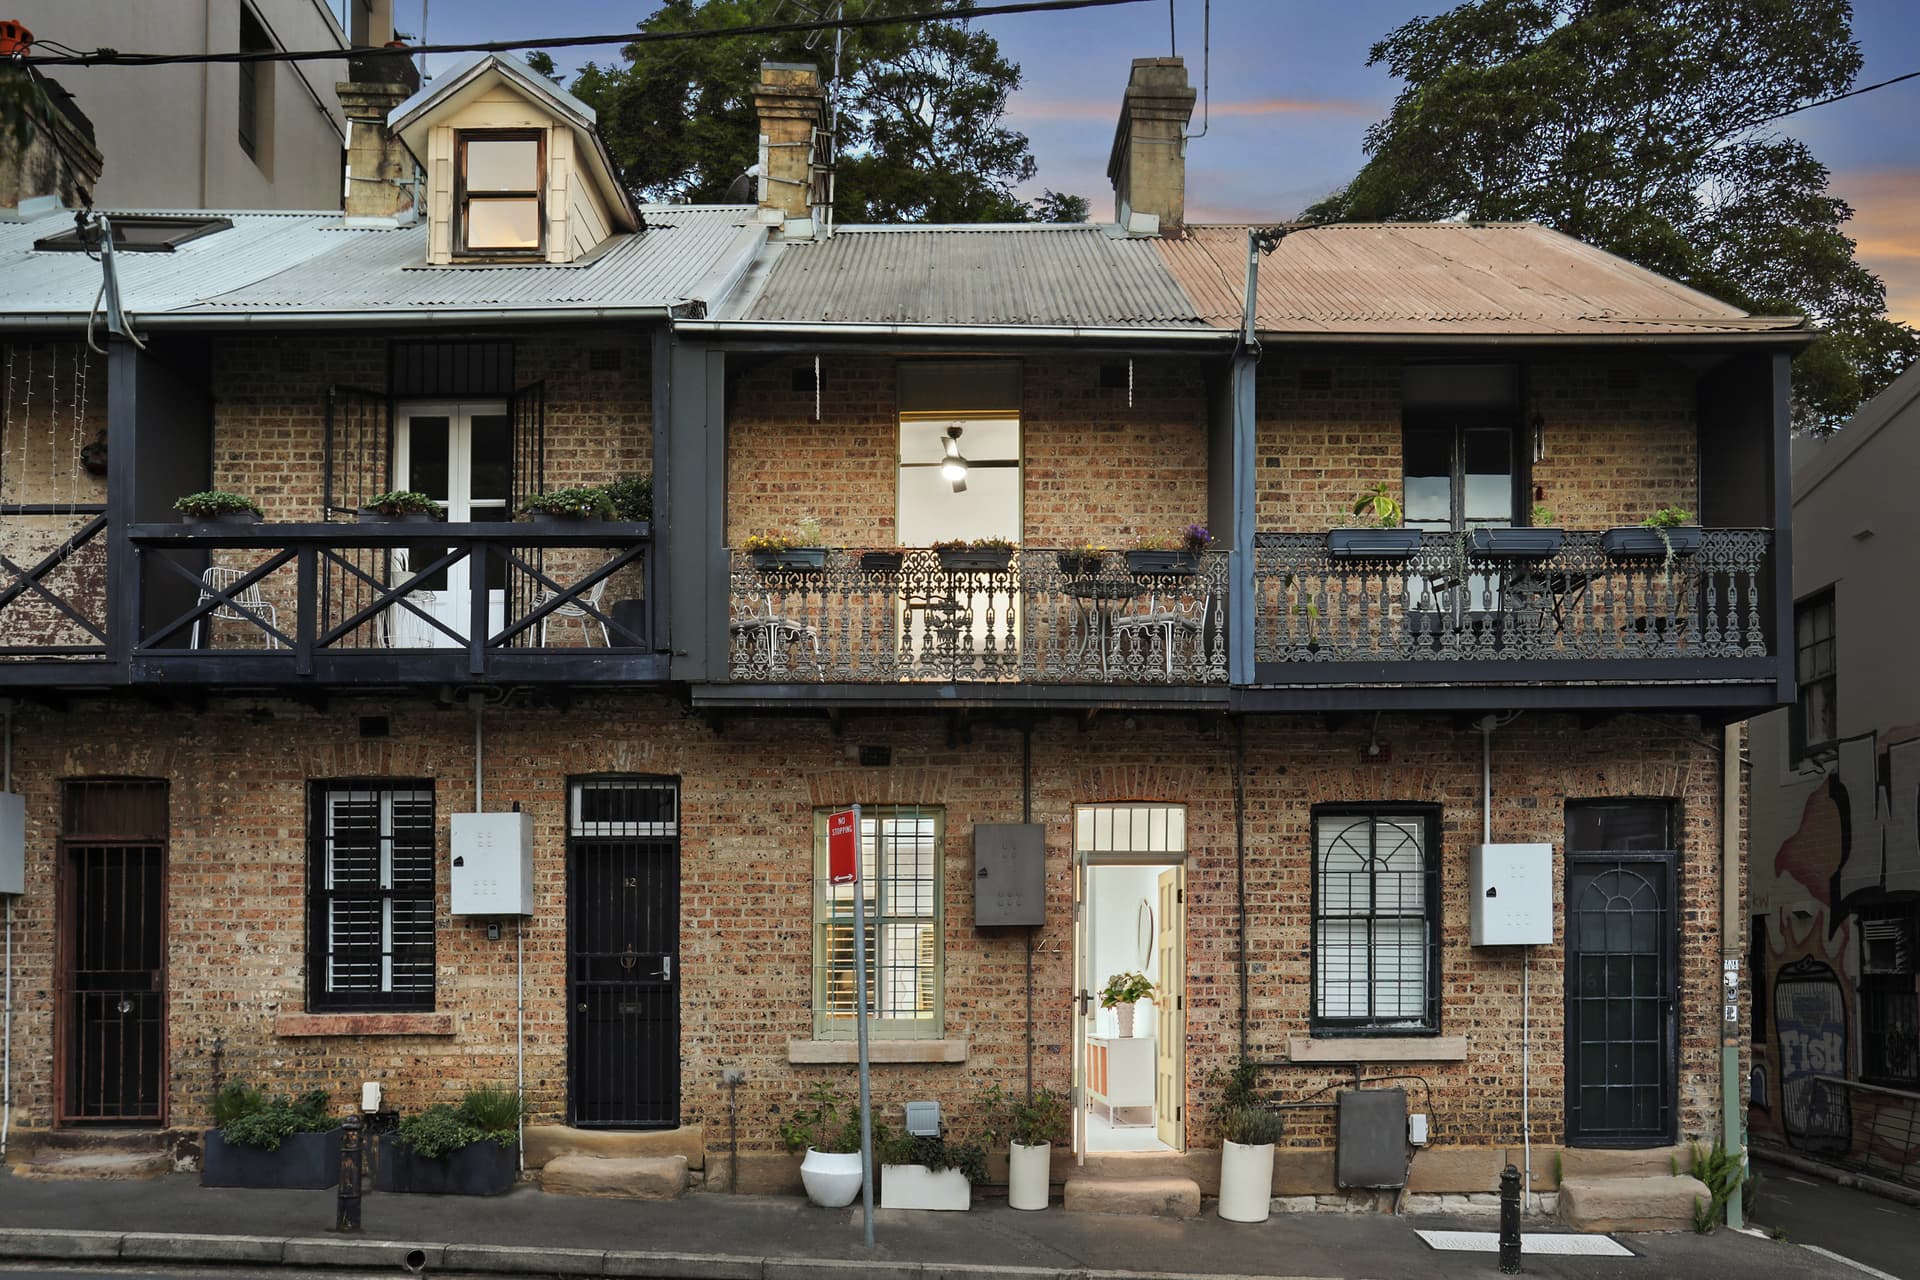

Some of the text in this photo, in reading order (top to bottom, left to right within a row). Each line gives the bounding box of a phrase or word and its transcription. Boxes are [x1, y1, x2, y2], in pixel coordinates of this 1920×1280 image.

[838, 816, 845, 825] NO
[832, 825, 852, 836] STOPPING
[1036, 938, 1062, 954] 44
